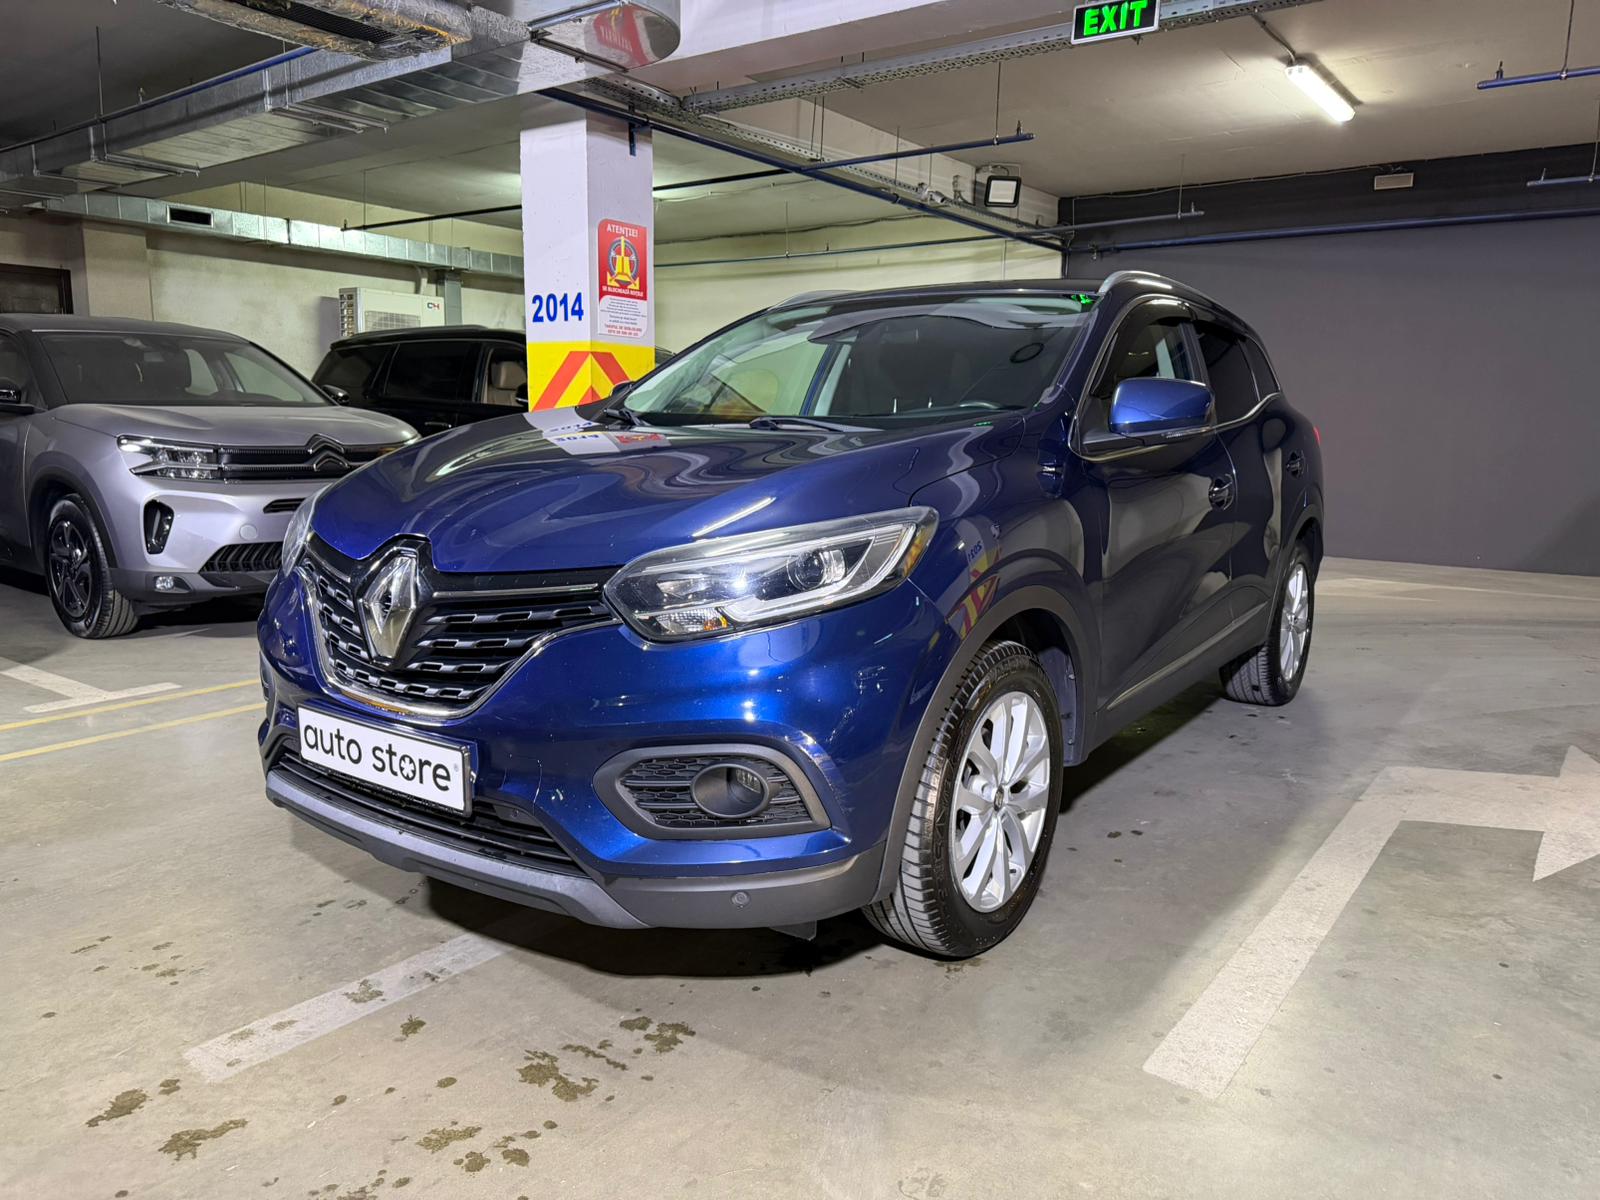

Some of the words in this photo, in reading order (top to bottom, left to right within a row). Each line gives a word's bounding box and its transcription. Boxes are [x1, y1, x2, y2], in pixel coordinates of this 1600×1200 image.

[1083, 0, 1148, 36] EXIT
[532, 291, 584, 323] 2014
[304, 724, 362, 765] auto
[372, 743, 451, 792] store
